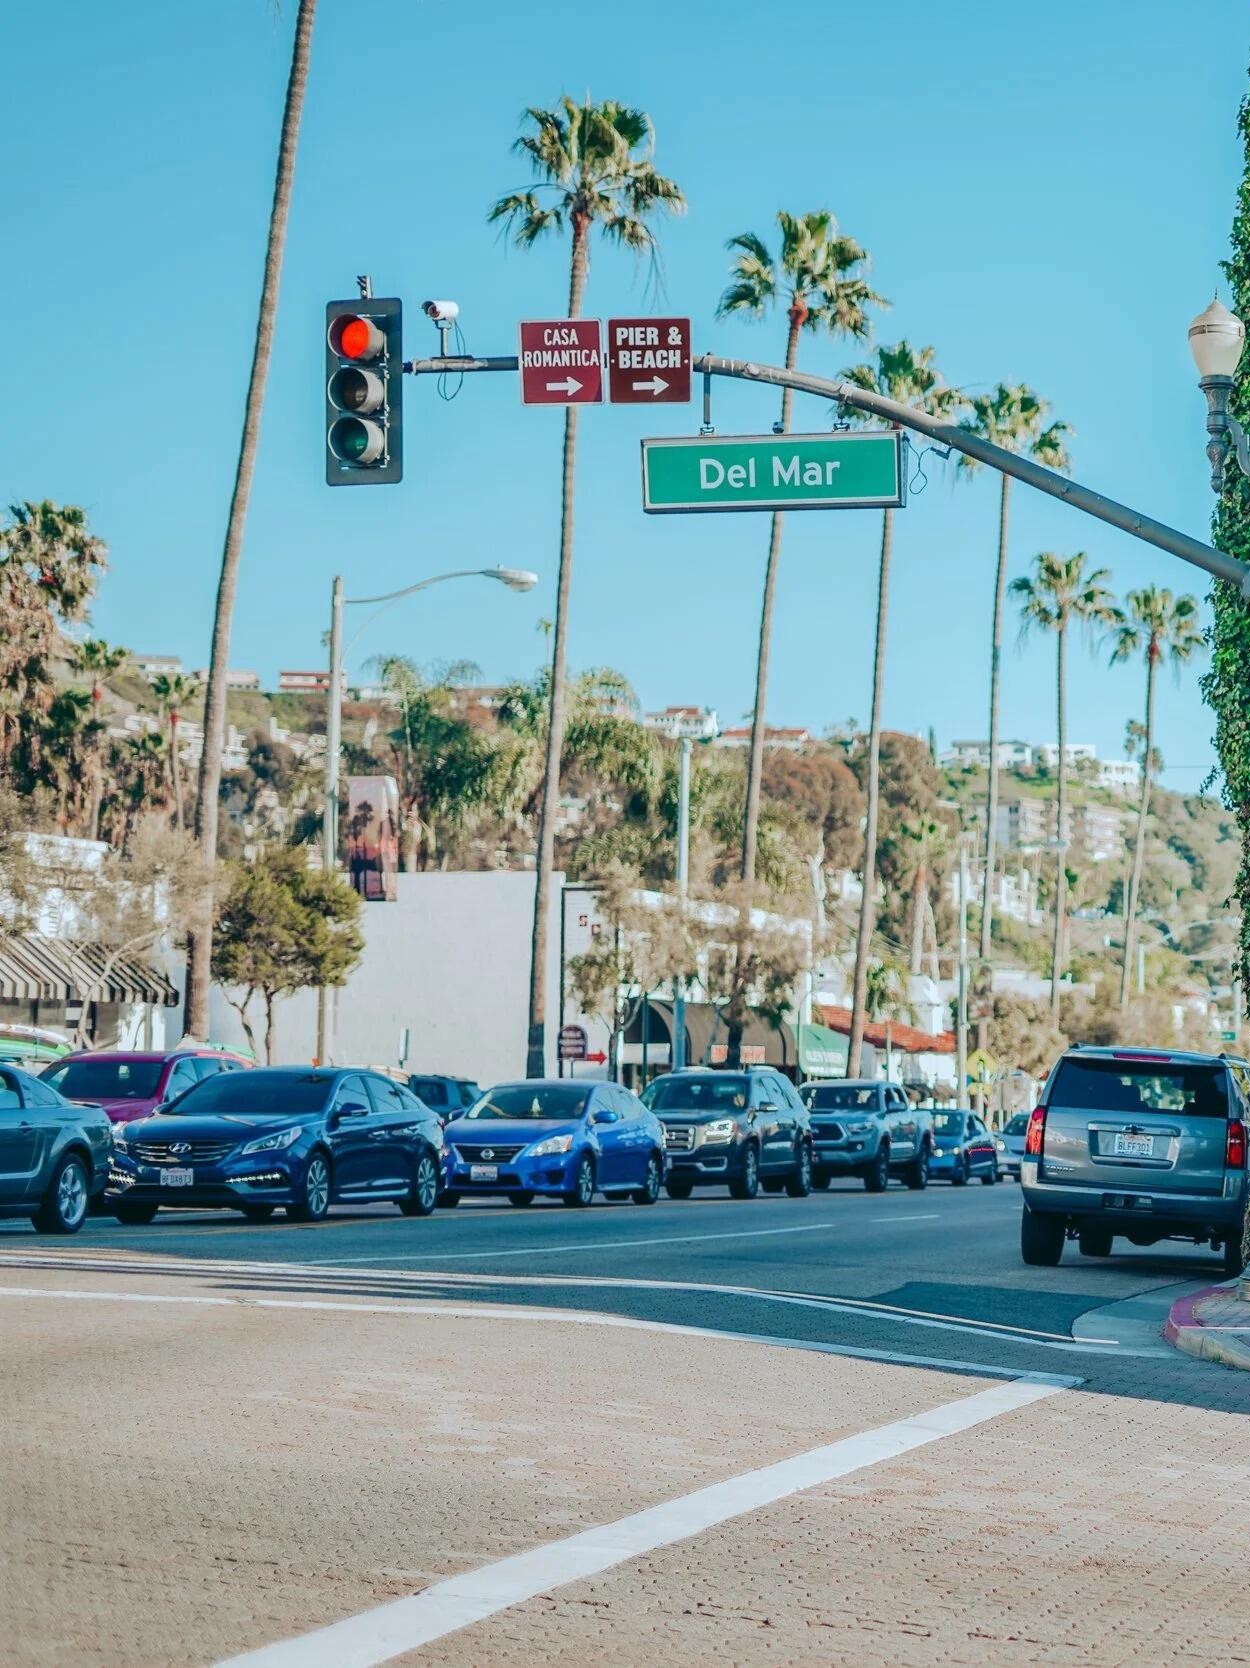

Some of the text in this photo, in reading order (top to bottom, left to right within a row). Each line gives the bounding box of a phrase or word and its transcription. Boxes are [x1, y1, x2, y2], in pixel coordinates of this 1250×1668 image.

[543, 328, 579, 346] CASA
[616, 326, 682, 346] PIER &
[524, 349, 600, 368] ROMANTICA
[618, 349, 681, 369] BEACH
[699, 455, 841, 490] Del Mar
